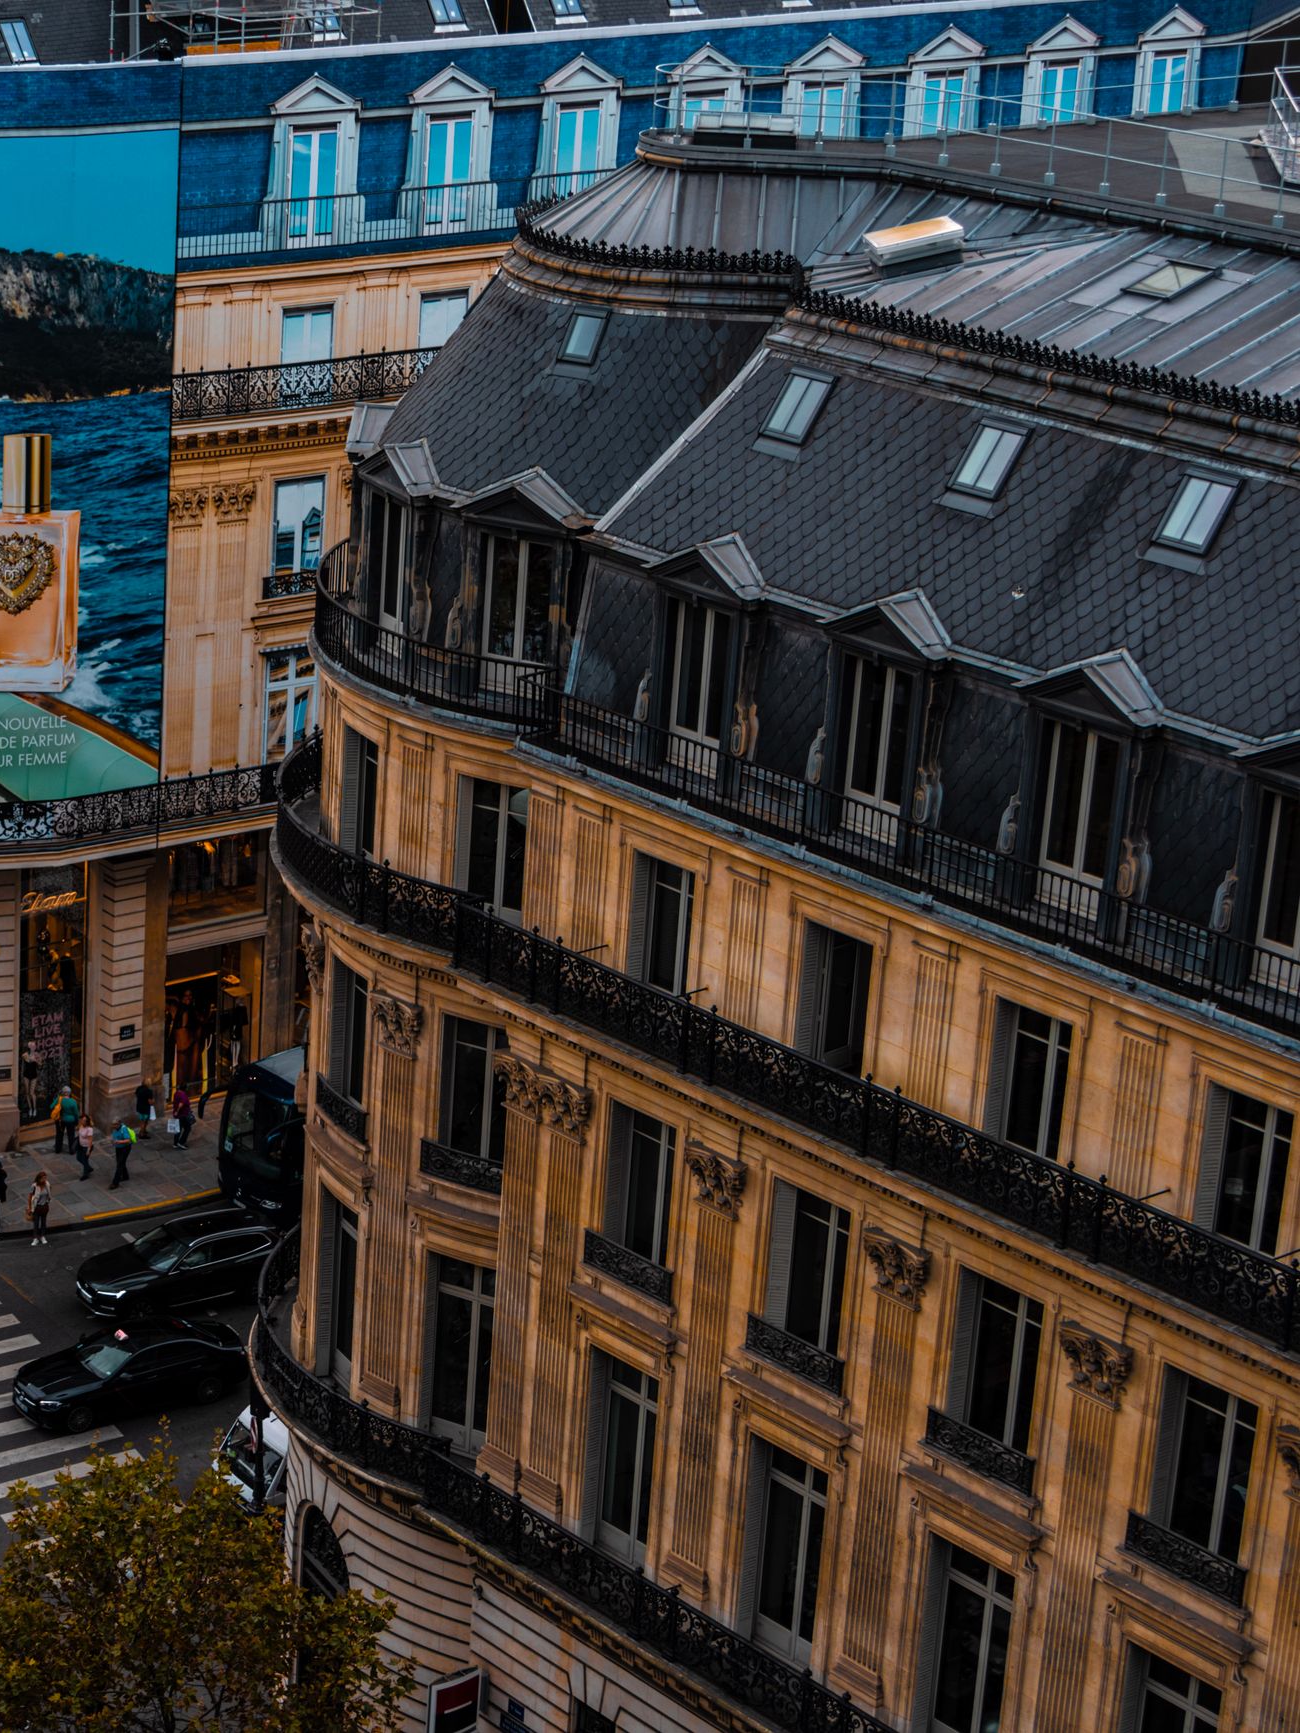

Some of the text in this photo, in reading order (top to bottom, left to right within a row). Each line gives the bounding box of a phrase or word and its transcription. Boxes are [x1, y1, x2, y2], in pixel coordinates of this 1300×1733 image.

[0, 736, 17, 749] DE
[21, 732, 76, 747] PARFUM
[18, 751, 67, 766] FEMME
[21, 891, 78, 912] Etam
[31, 1011, 64, 1028] ETAM
[34, 1023, 61, 1039] LIVE
[36, 1034, 66, 1051] HOW
